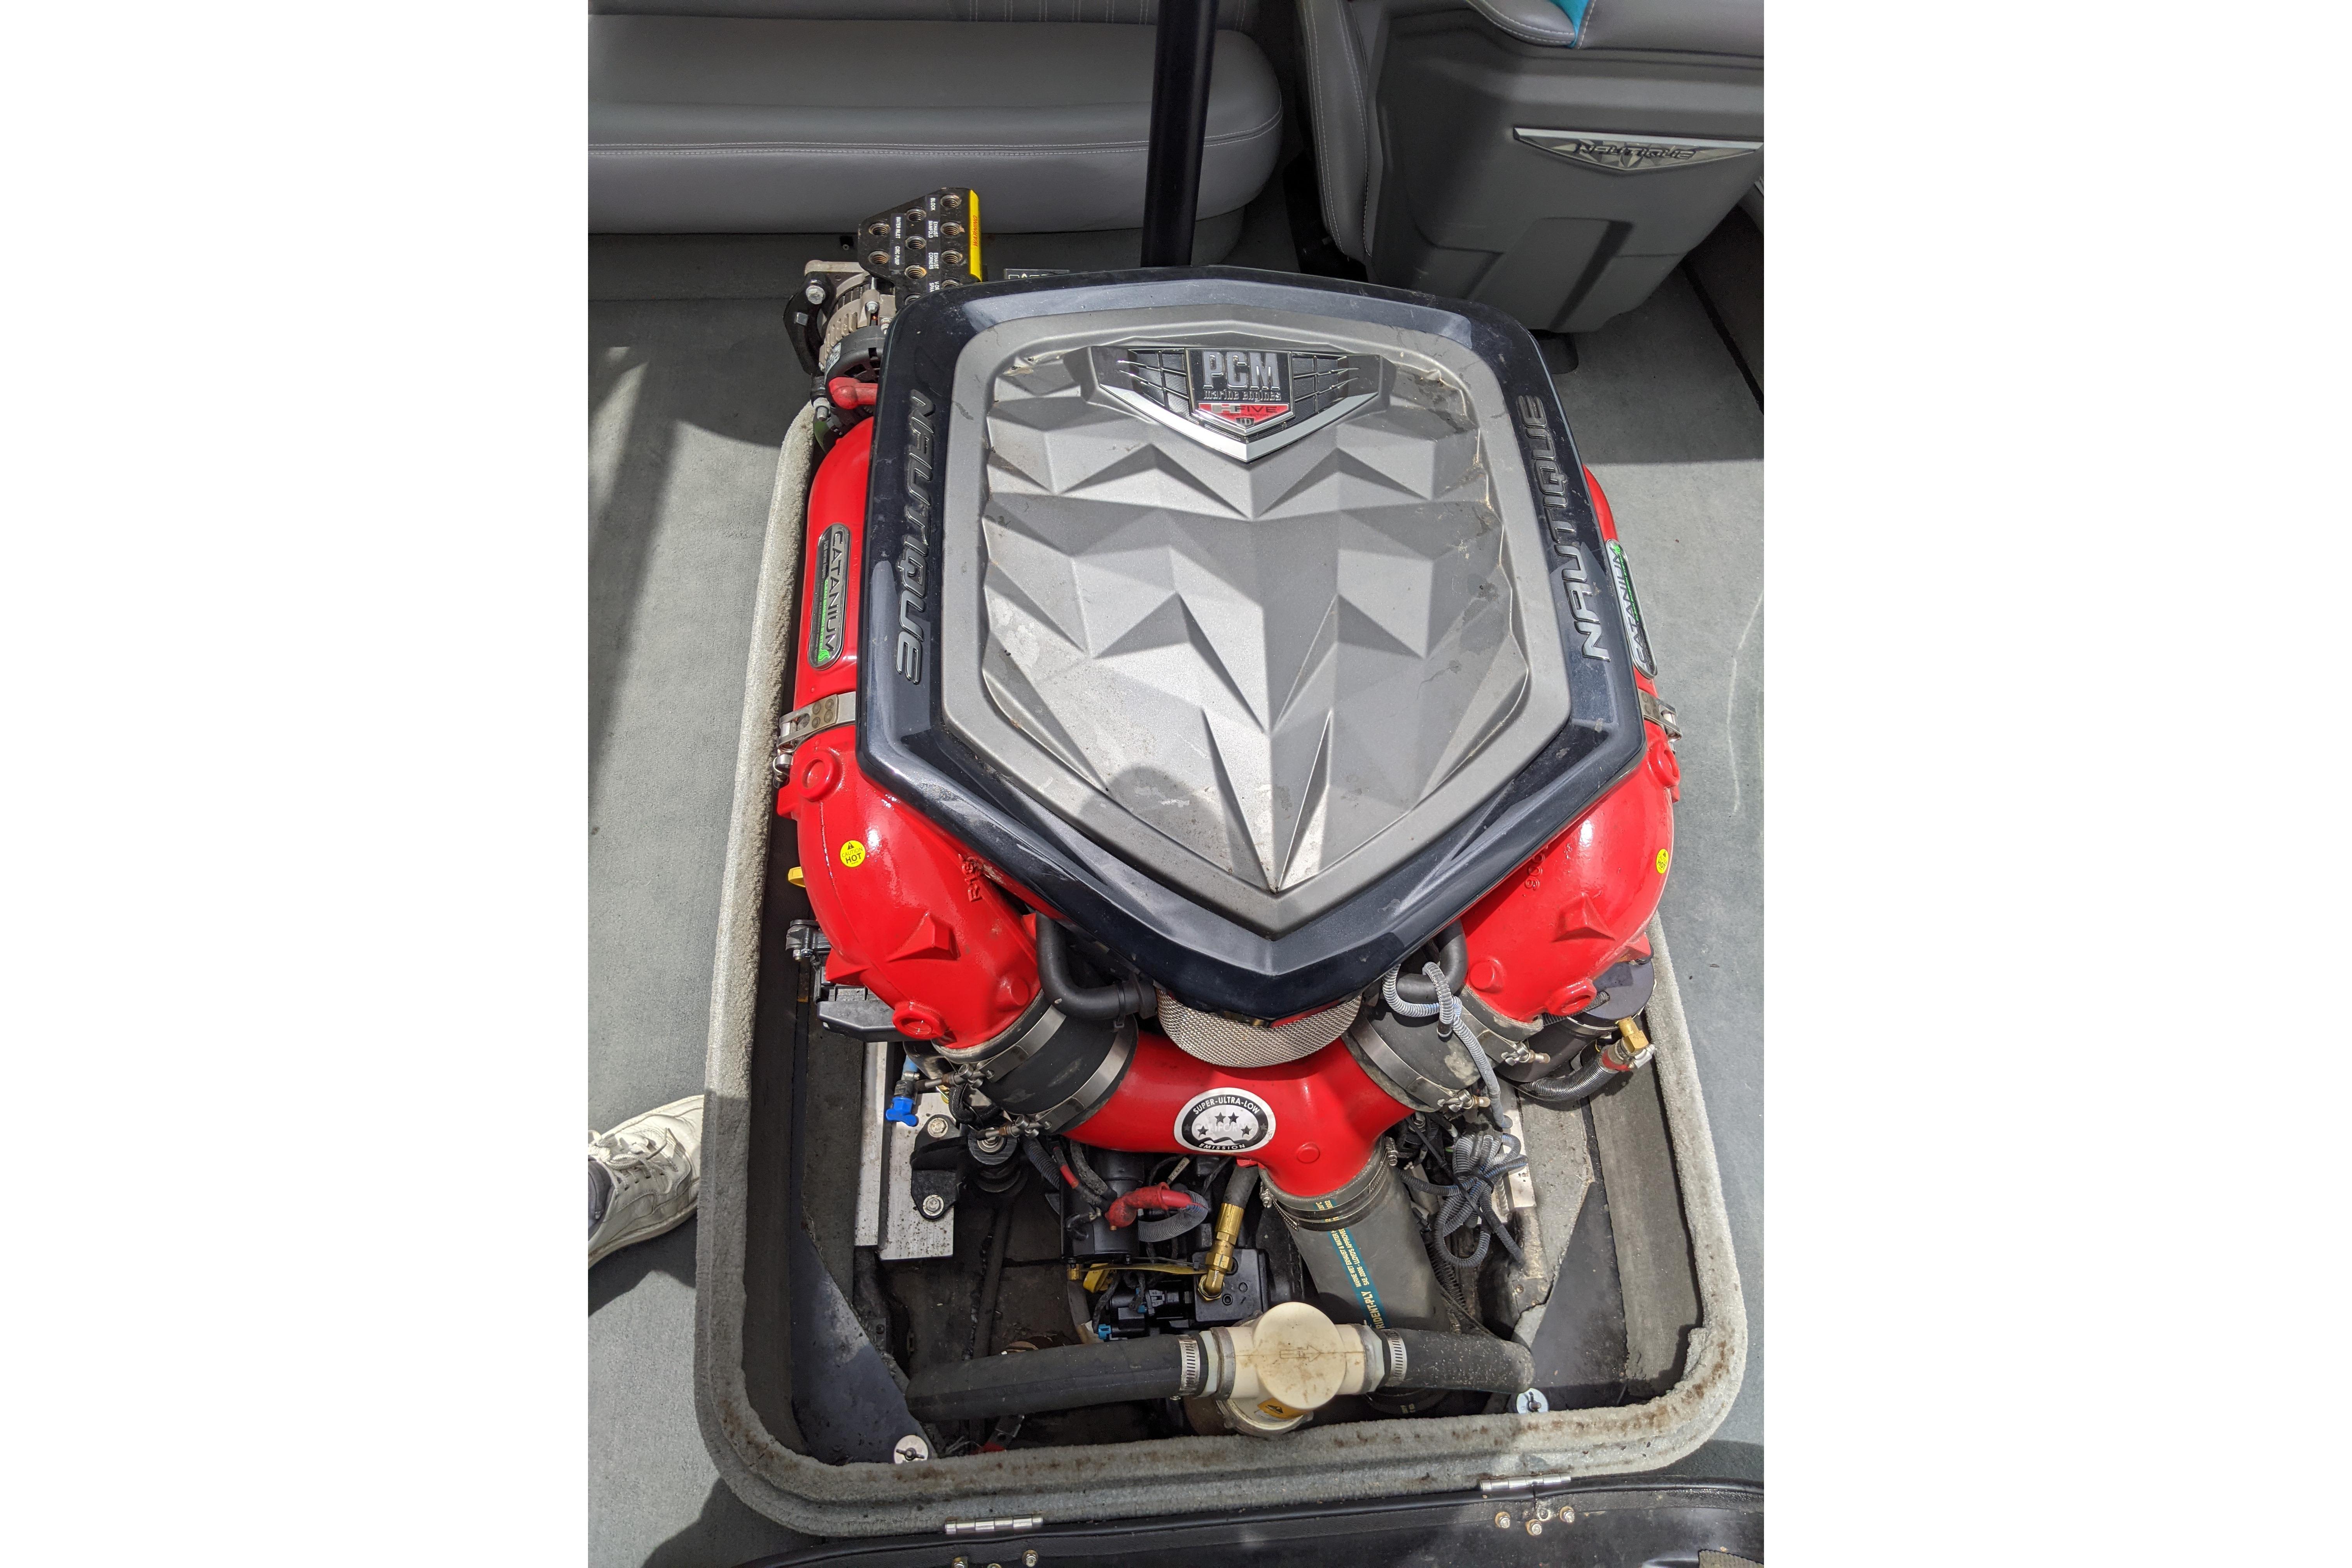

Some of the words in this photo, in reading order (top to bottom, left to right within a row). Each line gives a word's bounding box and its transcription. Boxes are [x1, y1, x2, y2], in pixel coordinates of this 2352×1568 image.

[1573, 143, 1698, 160] NAUTIQUE
[1202, 351, 1280, 390] PCM
[1516, 395, 1611, 662] NAUTIQUE
[896, 389, 935, 685] NAUTIQUE
[824, 531, 843, 652] CATANIUM
[1610, 547, 1646, 663] CATANIUM
[842, 847, 863, 858] CAUTION
[845, 852, 861, 864] HOT
[1657, 859, 1666, 870] HOT
[1193, 1096, 1260, 1115] SUPER-ULTRA-LOW
[1332, 1233, 1343, 1246] WATER
[1340, 1249, 1352, 1265] EXHAUST
[1356, 1266, 1366, 1277] J2006
[1351, 1273, 1362, 1287] MARINE
[1362, 1277, 1370, 1286] SAE
[1361, 1291, 1385, 1329] RIDENT-PLY
